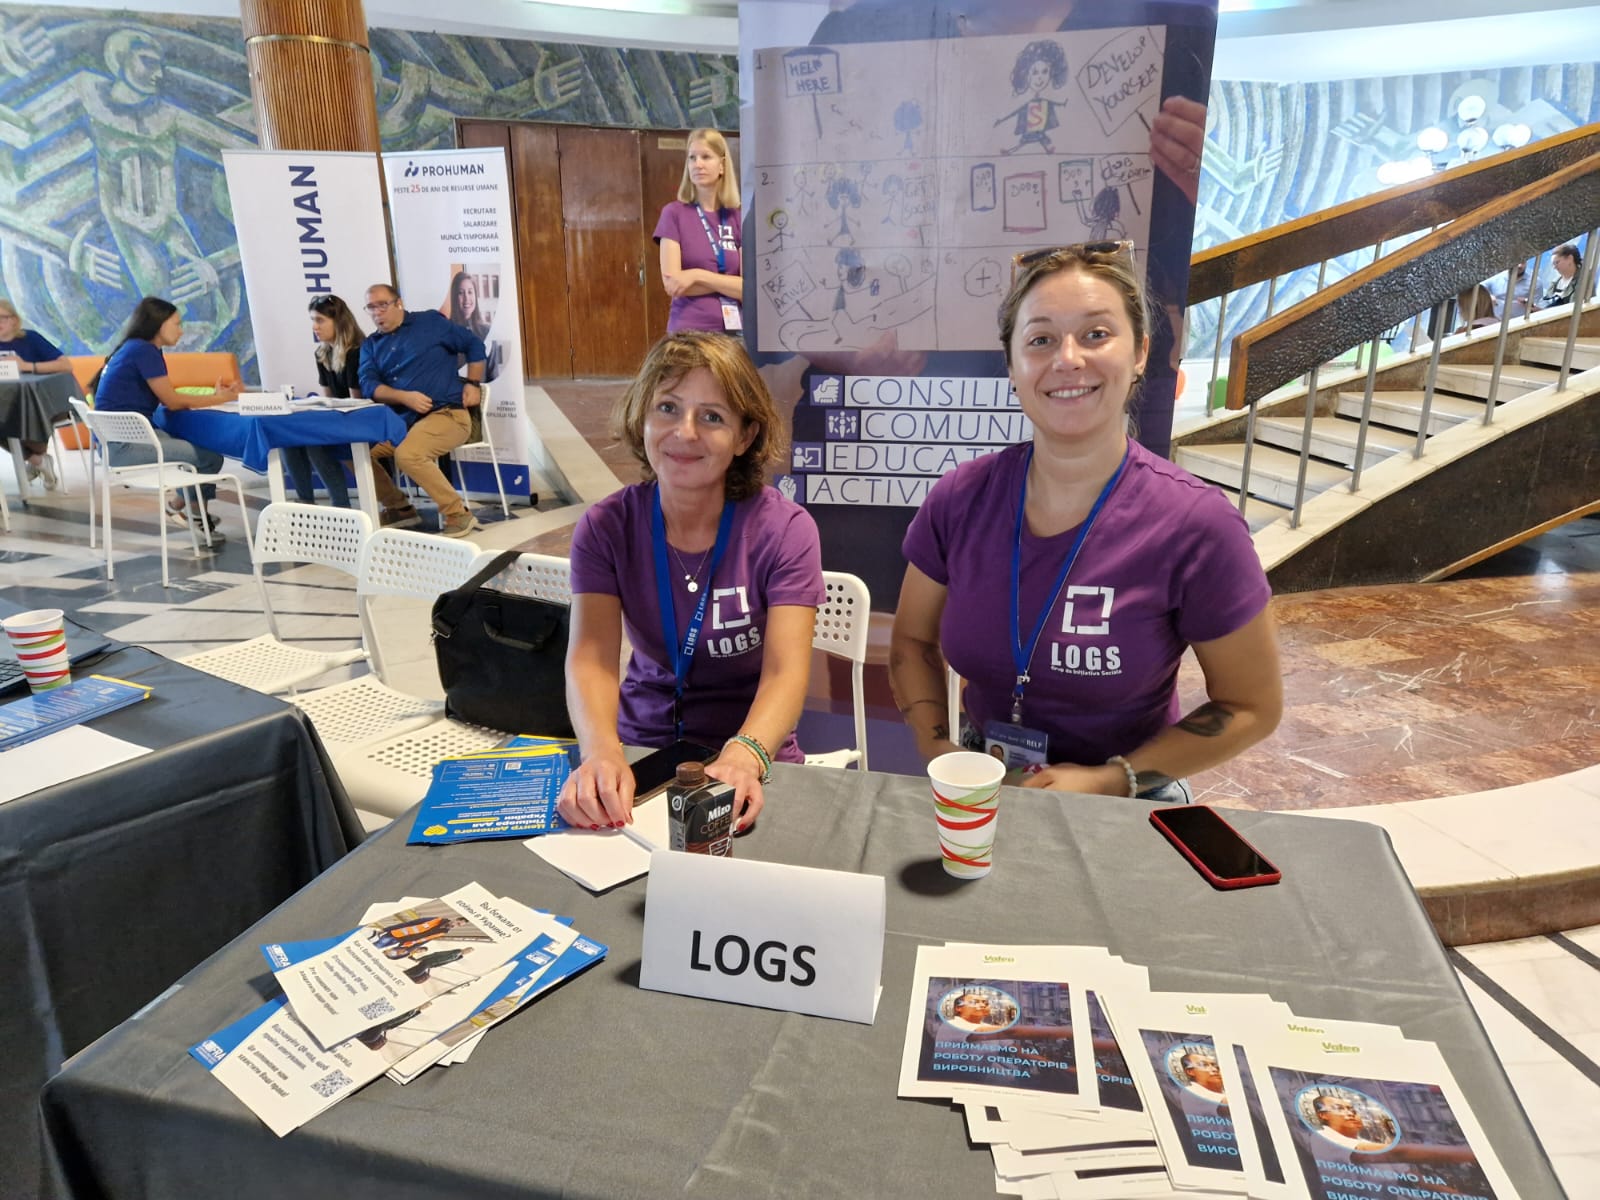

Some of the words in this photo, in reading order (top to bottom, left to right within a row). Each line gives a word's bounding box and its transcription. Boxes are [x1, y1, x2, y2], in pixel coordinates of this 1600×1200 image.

[789, 59, 823, 76] HELP
[1086, 36, 1146, 88] DEVELOP
[796, 76, 830, 92] HERE
[422, 163, 484, 177] PROHUMAN
[411, 184, 420, 193] 25
[288, 165, 332, 293] HUMAN
[865, 412, 1024, 440] COMUNI
[833, 445, 994, 472] EDUCAT
[707, 626, 760, 655] LOGS
[1051, 642, 1120, 670] LOGS
[708, 804, 731, 822] Mizo
[690, 930, 816, 986] LOGS
[935, 1040, 1018, 1053] ПРИЙМАЄМО
[1322, 1042, 1361, 1053] Valeo
[934, 1052, 983, 1062] РОБОТУ
[987, 1055, 1069, 1070] ОПЕРАТОРІВ
[933, 1063, 1031, 1078] ВИРОБНИЦТВА
[1097, 1074, 1132, 1085] ОРІВ
[1192, 1129, 1235, 1140] РОБО
[1315, 1159, 1419, 1182] ПРИЙМАЄМО
[1422, 1176, 1447, 1186] НА
[1321, 1175, 1382, 1192] РОБОТУ
